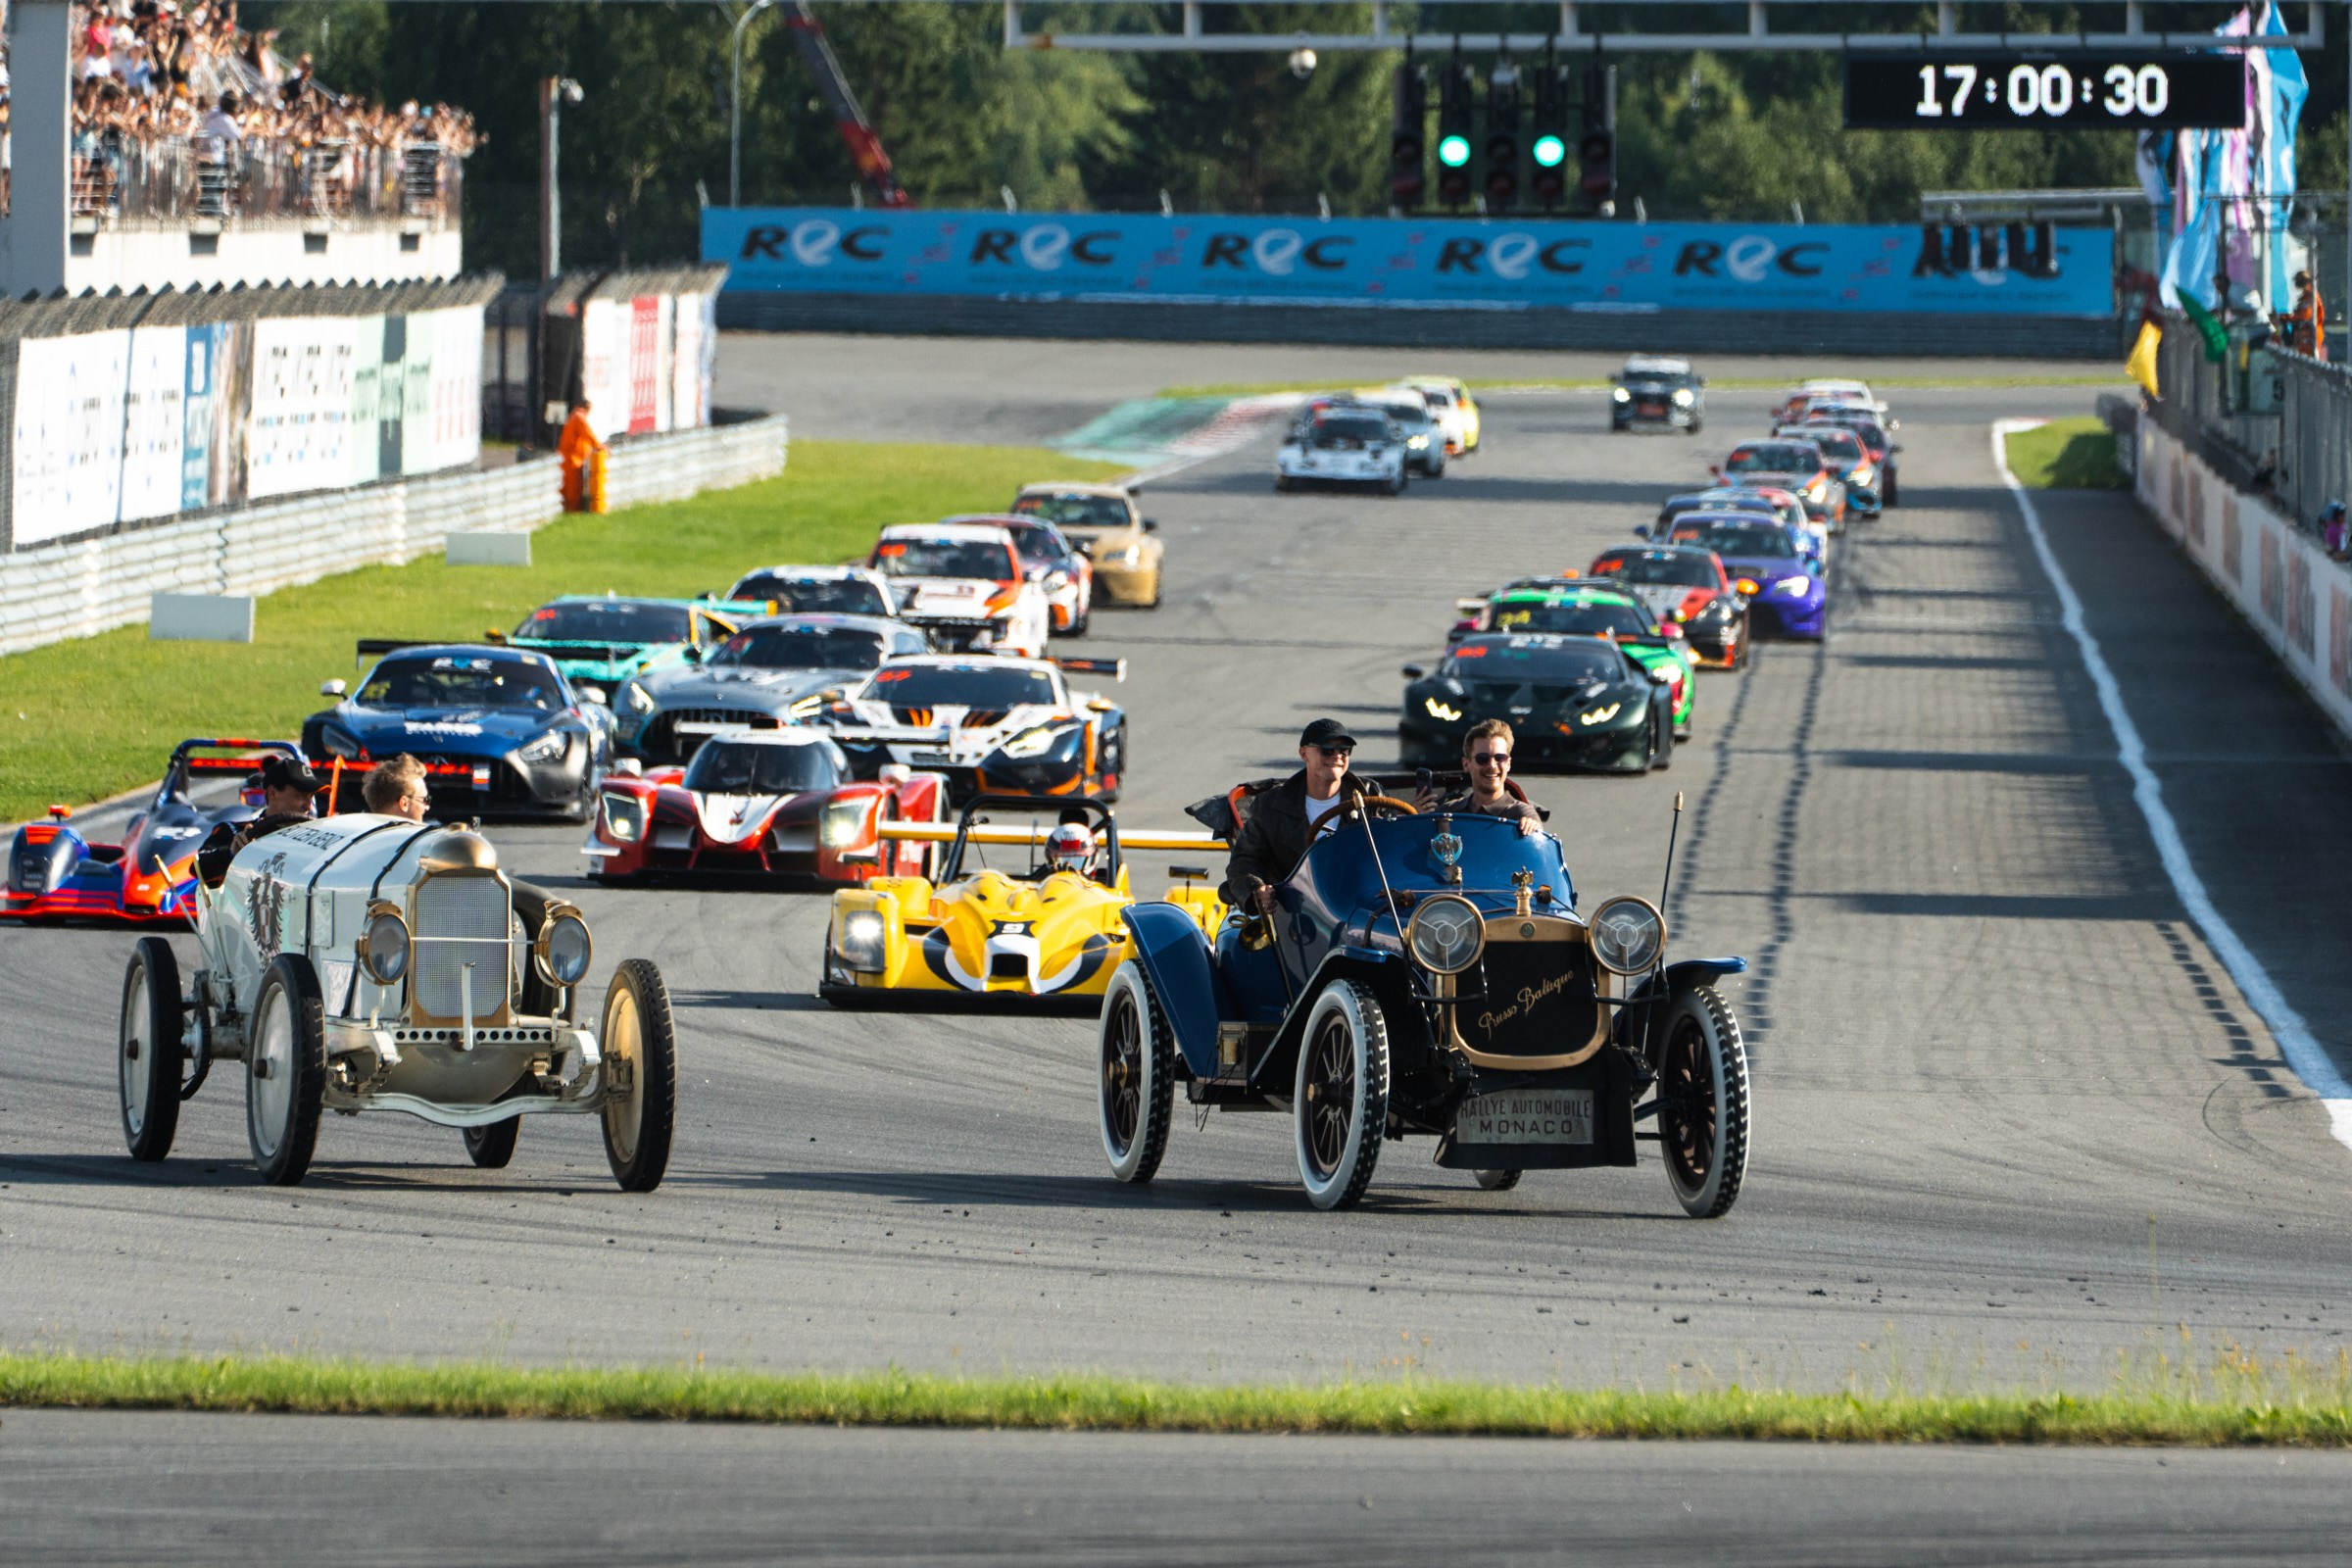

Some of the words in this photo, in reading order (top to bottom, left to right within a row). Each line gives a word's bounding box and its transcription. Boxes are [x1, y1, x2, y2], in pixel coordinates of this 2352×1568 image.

[1915, 64, 2169, 117] 17:00:30
[308, 831, 344, 851] BENZ
[1478, 1004, 1518, 1040] Russo
[1460, 1099, 1506, 1118] RALLYE
[1511, 1099, 1591, 1117] AUTOMOBILE
[1479, 1119, 1572, 1135] MONACO
